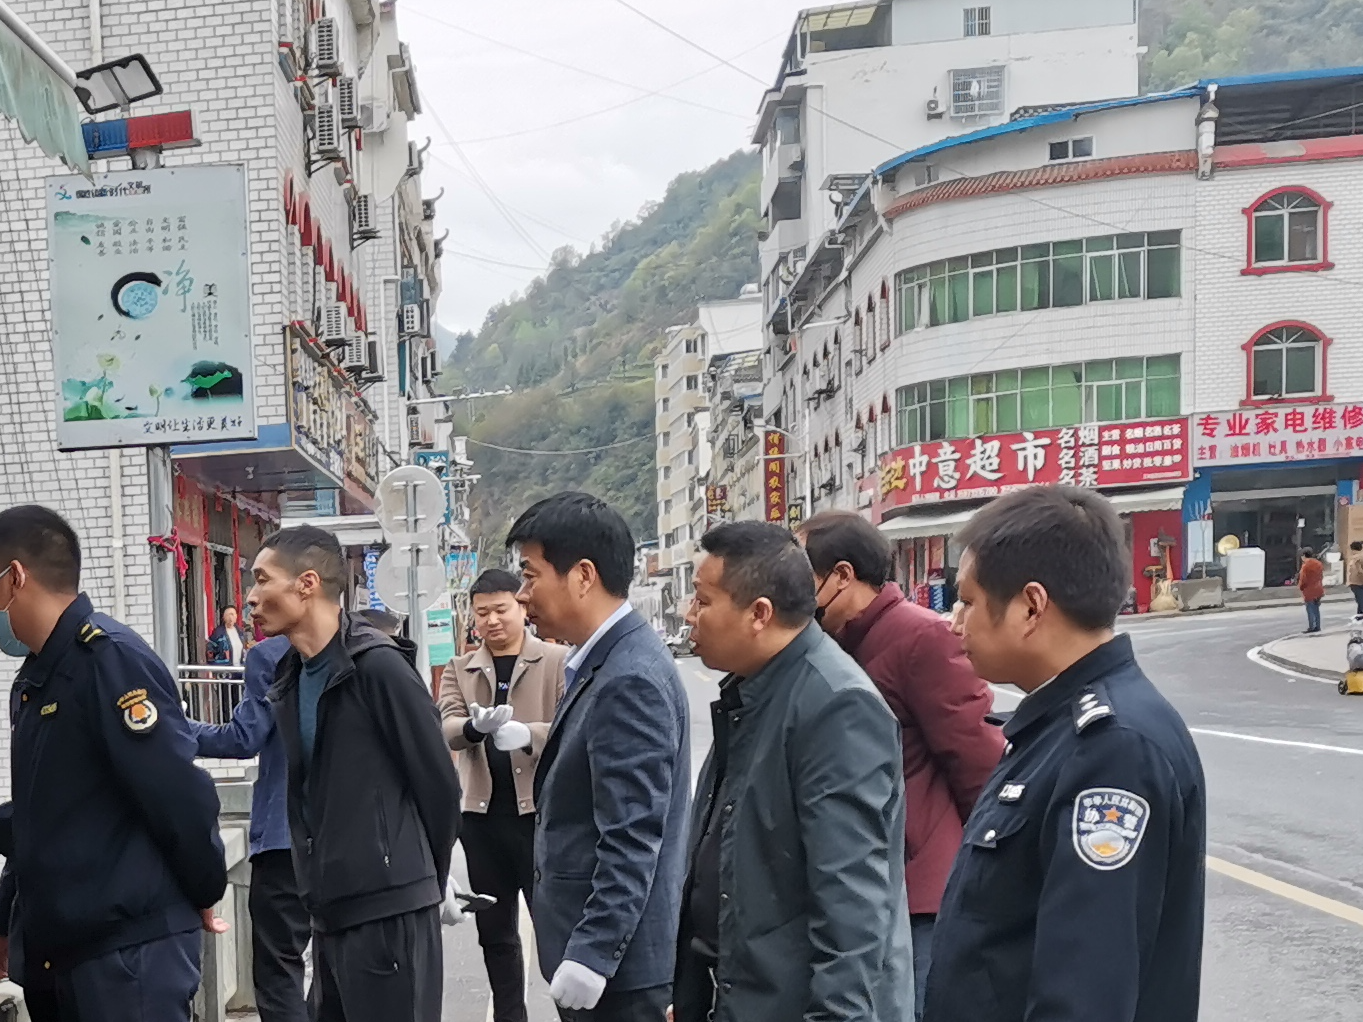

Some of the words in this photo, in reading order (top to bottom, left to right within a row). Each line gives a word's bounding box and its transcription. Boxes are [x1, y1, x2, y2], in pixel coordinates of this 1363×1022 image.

[1197, 404, 1363, 438] 专业家电维修
[908, 431, 1052, 492] 中意超市
